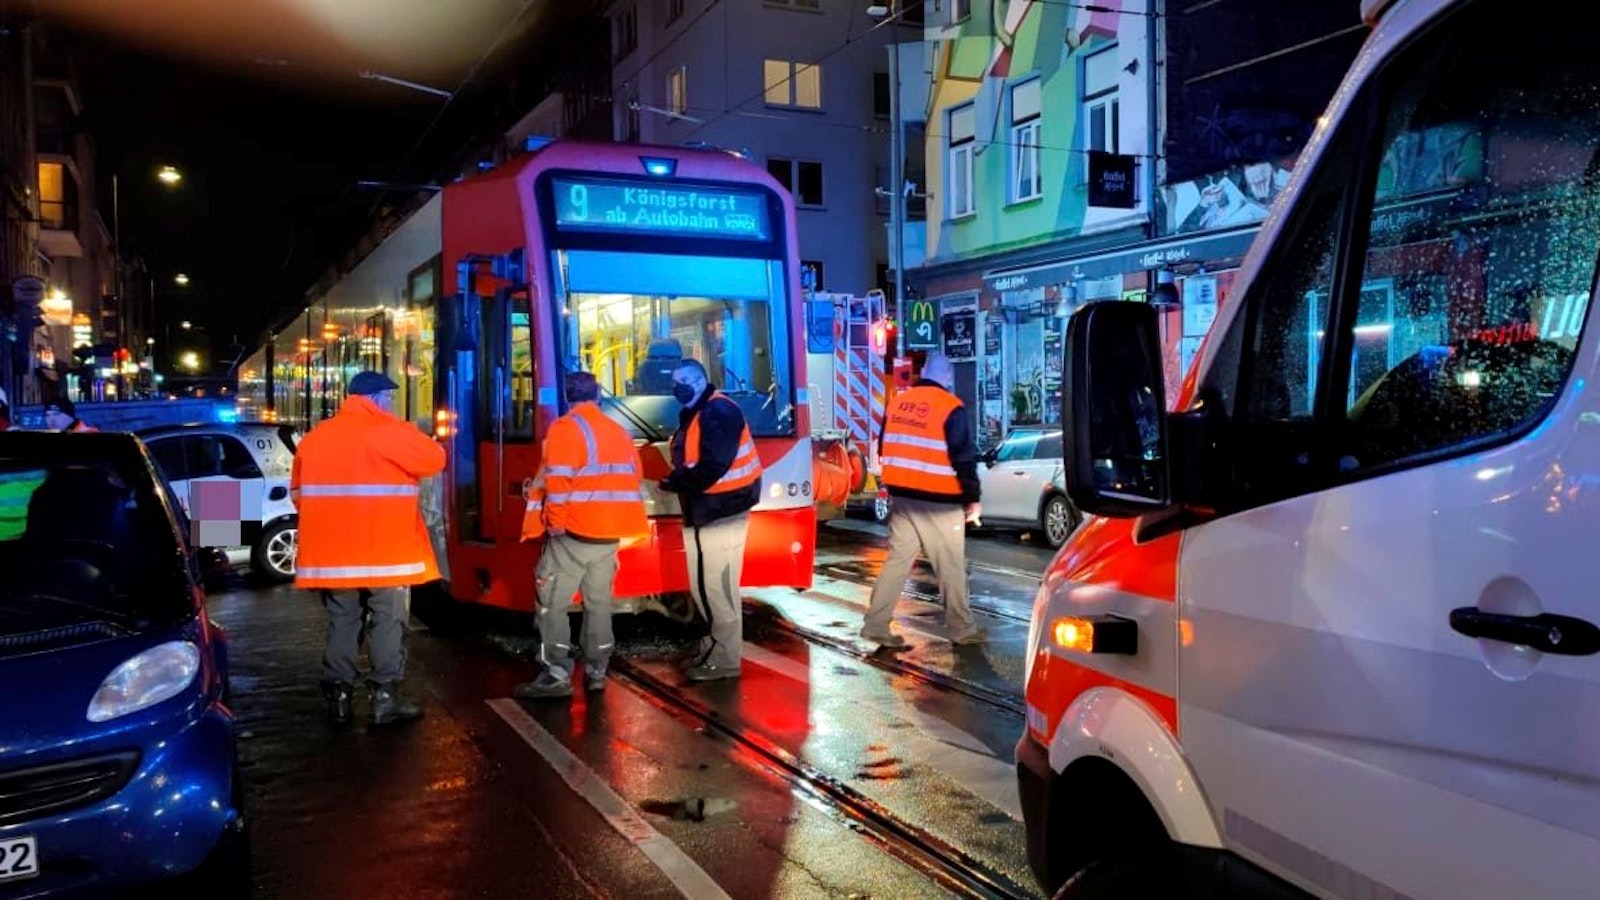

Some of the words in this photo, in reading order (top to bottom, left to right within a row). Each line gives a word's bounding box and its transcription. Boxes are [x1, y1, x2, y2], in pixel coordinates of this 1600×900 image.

[570, 184, 588, 221] 9
[624, 187, 736, 211] Königsforst
[606, 206, 626, 223] ab
[634, 207, 719, 229] Autobahn
[256, 439, 273, 450] 01
